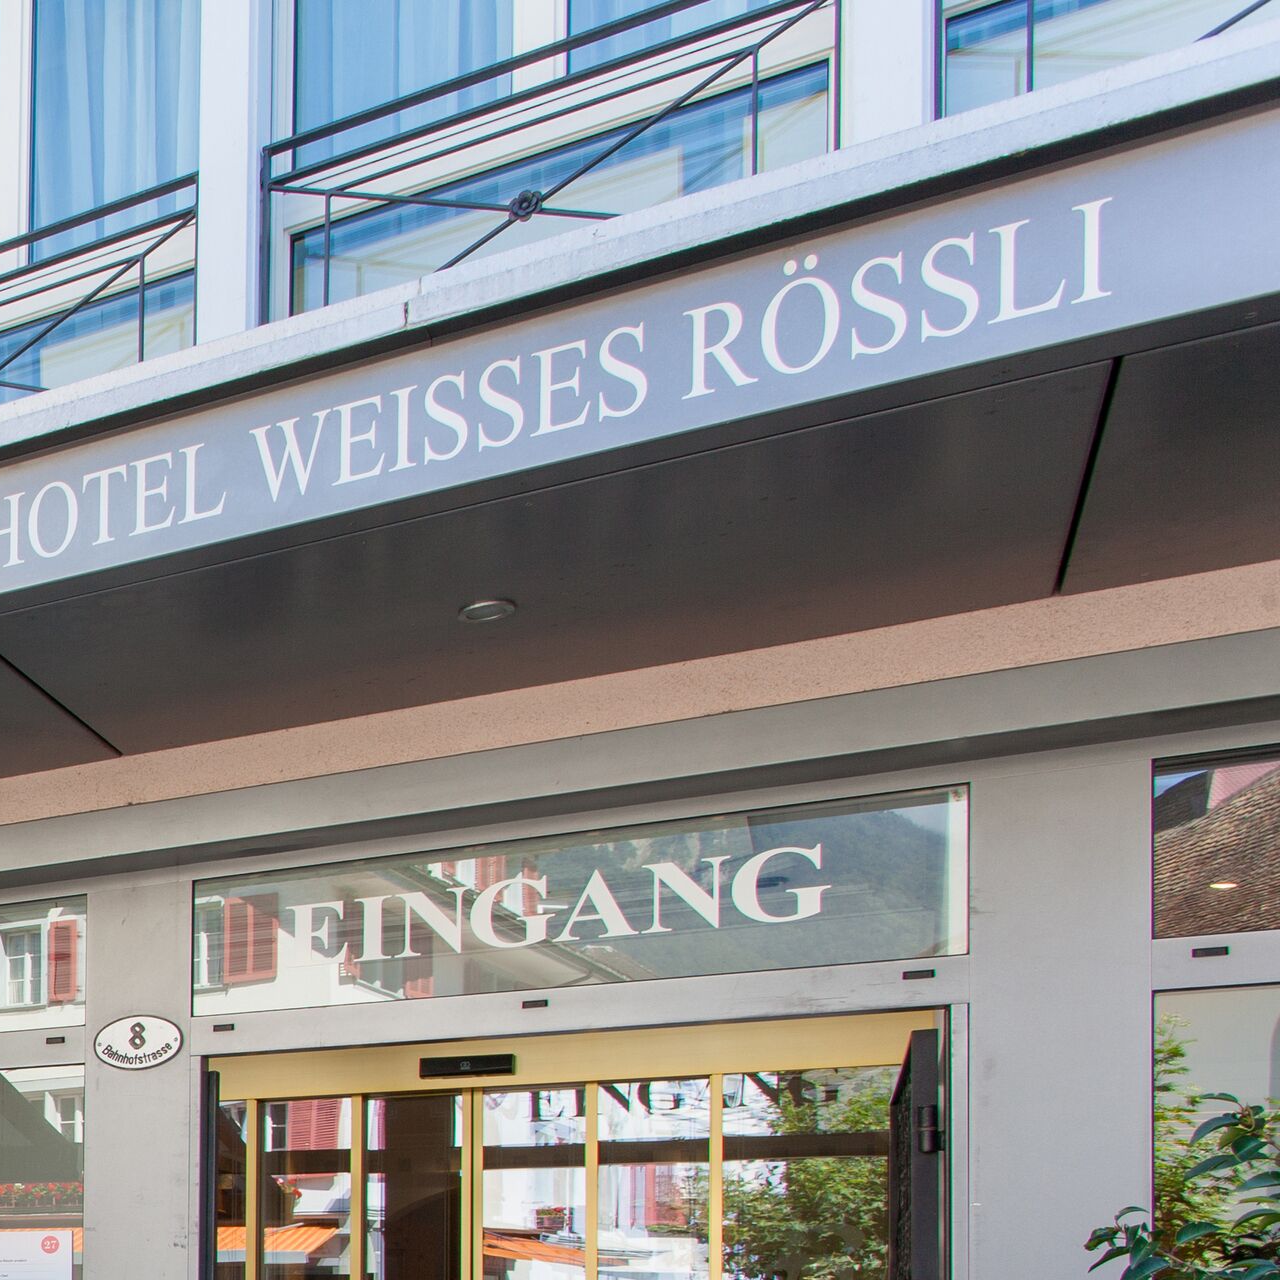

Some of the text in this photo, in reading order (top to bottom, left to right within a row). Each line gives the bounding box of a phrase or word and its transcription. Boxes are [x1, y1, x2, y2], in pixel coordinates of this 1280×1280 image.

[249, 321, 648, 504] WEISSES
[681, 196, 1114, 401] RÖSSLI
[284, 842, 832, 966] EINGANG
[128, 1022, 146, 1050] 8
[101, 1042, 173, 1065] Bahnhofstrasse
[44, 1240, 57, 1250] 27
